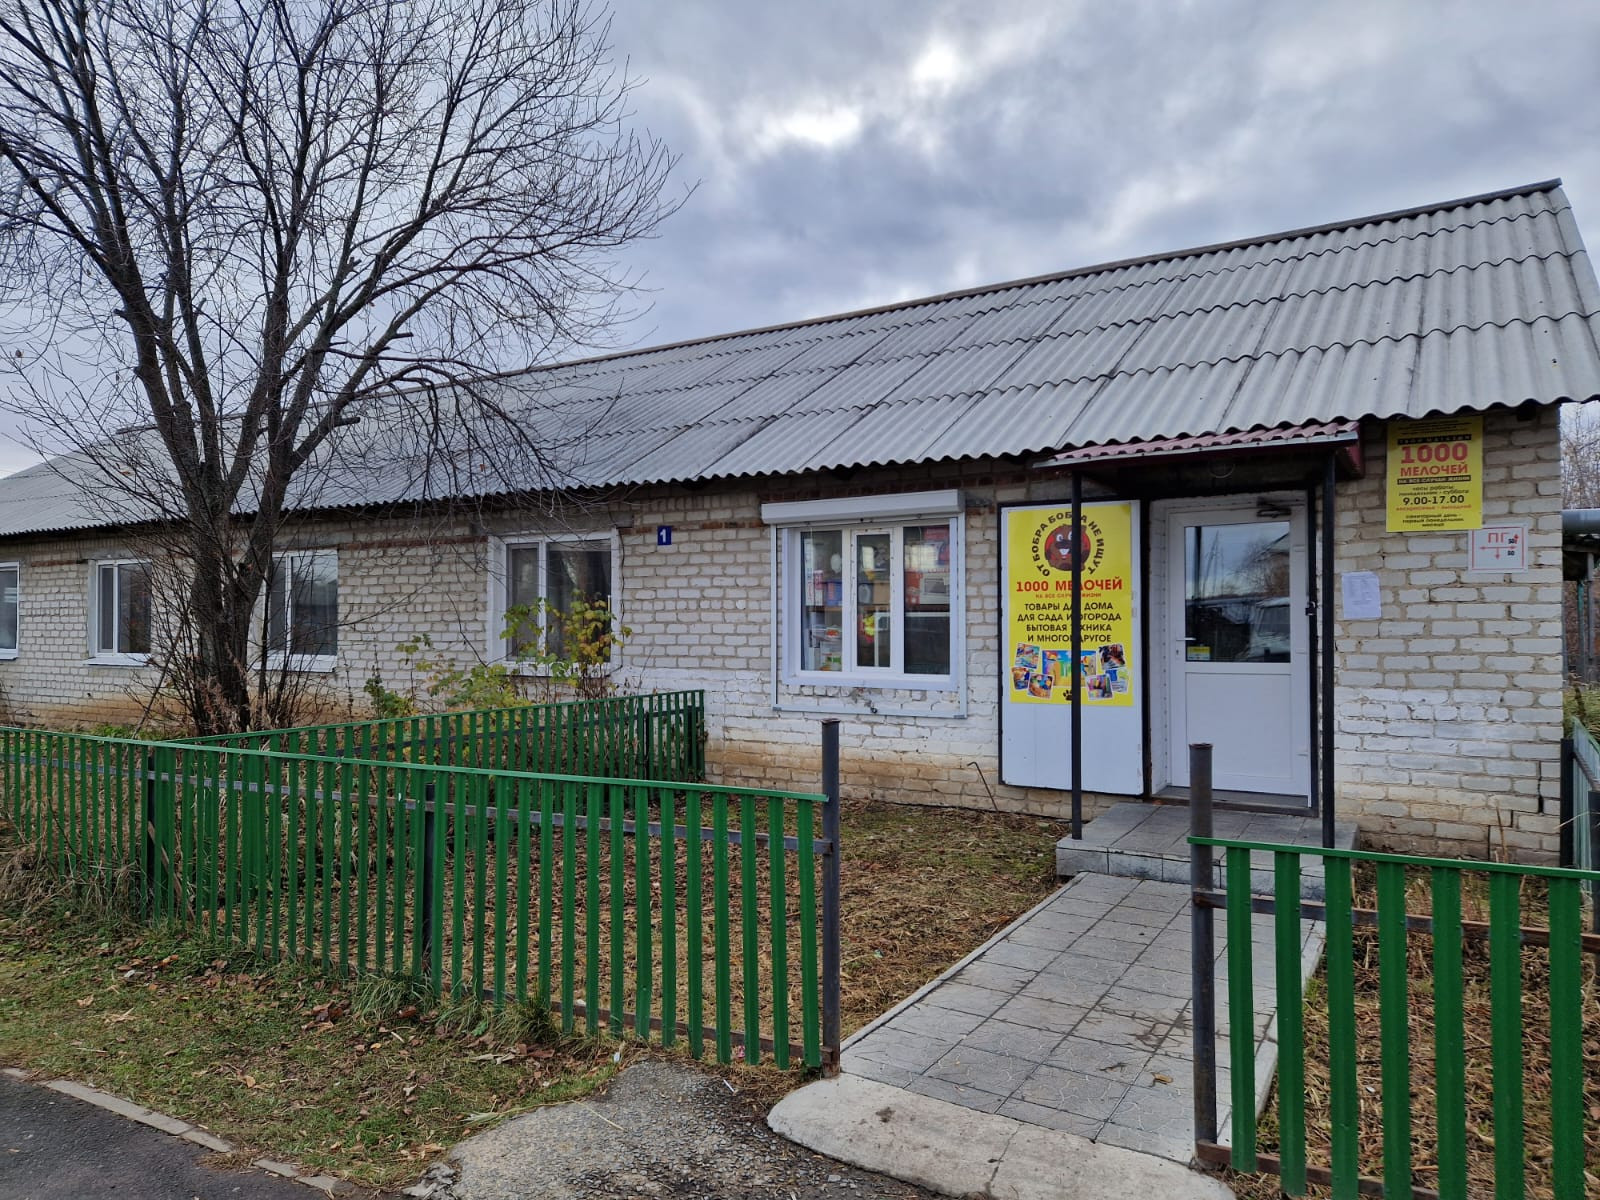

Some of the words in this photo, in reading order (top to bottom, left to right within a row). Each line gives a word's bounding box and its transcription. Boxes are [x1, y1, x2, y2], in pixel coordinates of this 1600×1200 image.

[1401, 442, 1468, 464] 1000
[1400, 461, 1468, 477] МЕЛОЧЕЙ
[1403, 495, 1465, 505] 9.00-17.00
[1048, 512, 1087, 524] БОБА
[1088, 521, 1102, 537] НЕ
[660, 528, 667, 543] 1
[1488, 532, 1510, 543] ПГ
[1032, 523, 1048, 562] БОБРА
[1087, 538, 1104, 575] ИЩУТ
[1037, 564, 1050, 576] ОТ
[1016, 581, 1049, 592] 1000
[1024, 603, 1060, 611] ТОВАРЫ
[1084, 602, 1113, 611] ДОМА
[1017, 614, 1035, 622] ДЛЯ
[1037, 613, 1063, 622] САДА
[1026, 624, 1067, 632] БЫТОВАЯ
[1073, 624, 1112, 632] ХНИКА
[1027, 634, 1034, 642] И
[1037, 634, 1073, 642] МНОГО
